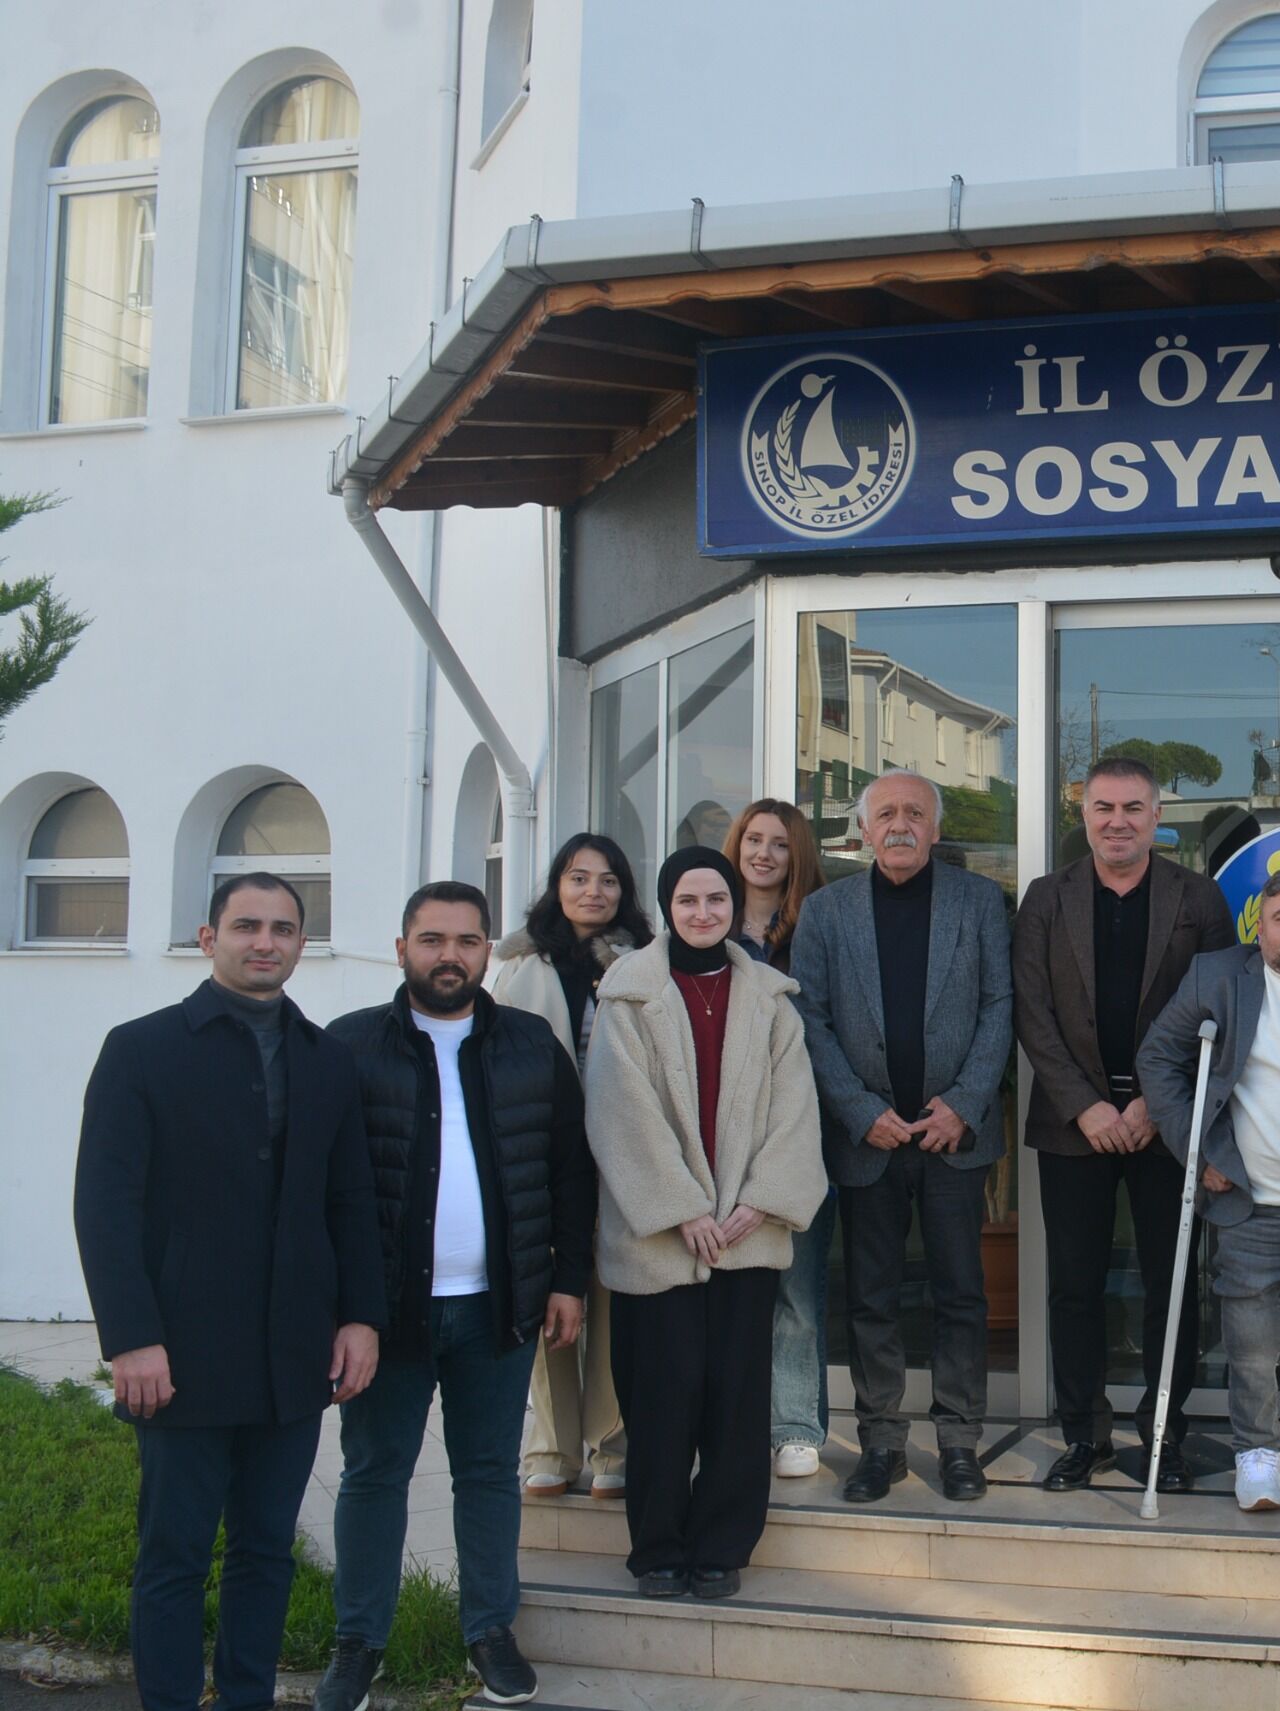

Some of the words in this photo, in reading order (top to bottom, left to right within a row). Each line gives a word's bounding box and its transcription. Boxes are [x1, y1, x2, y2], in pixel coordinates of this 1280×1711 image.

[1015, 343, 1109, 416] İL
[754, 450, 786, 505] SİNOP
[789, 503, 803, 520] İL
[811, 510, 859, 524] ÖZEL
[863, 441, 904, 511] İDARESİ
